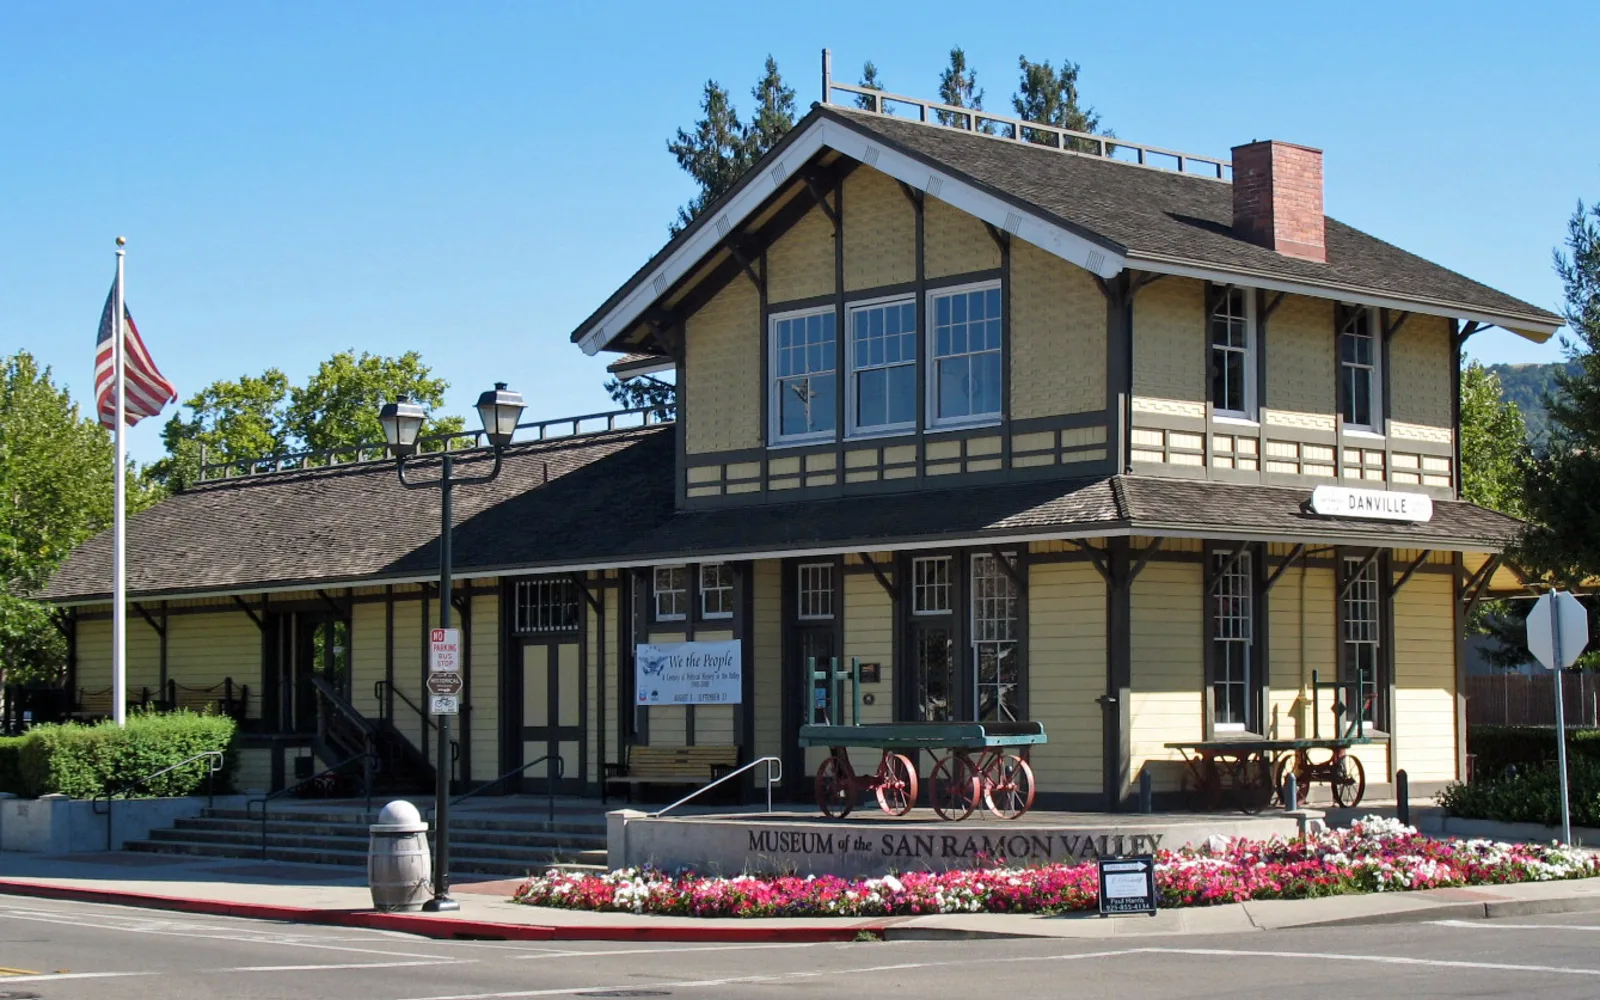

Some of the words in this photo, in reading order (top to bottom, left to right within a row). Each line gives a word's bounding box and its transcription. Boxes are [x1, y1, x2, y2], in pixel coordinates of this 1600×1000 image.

[1349, 494, 1407, 514] DANVILLE
[433, 631, 443, 641] NO
[433, 644, 457, 652] PARKING
[669, 655, 682, 668] We
[685, 652, 699, 668] the
[703, 650, 733, 673] People
[748, 830, 834, 854] MUSEUM
[838, 834, 850, 853] of
[853, 836, 872, 851] the
[881, 834, 933, 857] SAN
[941, 835, 1054, 858] RAMON
[1059, 833, 1163, 858] VALLEY
